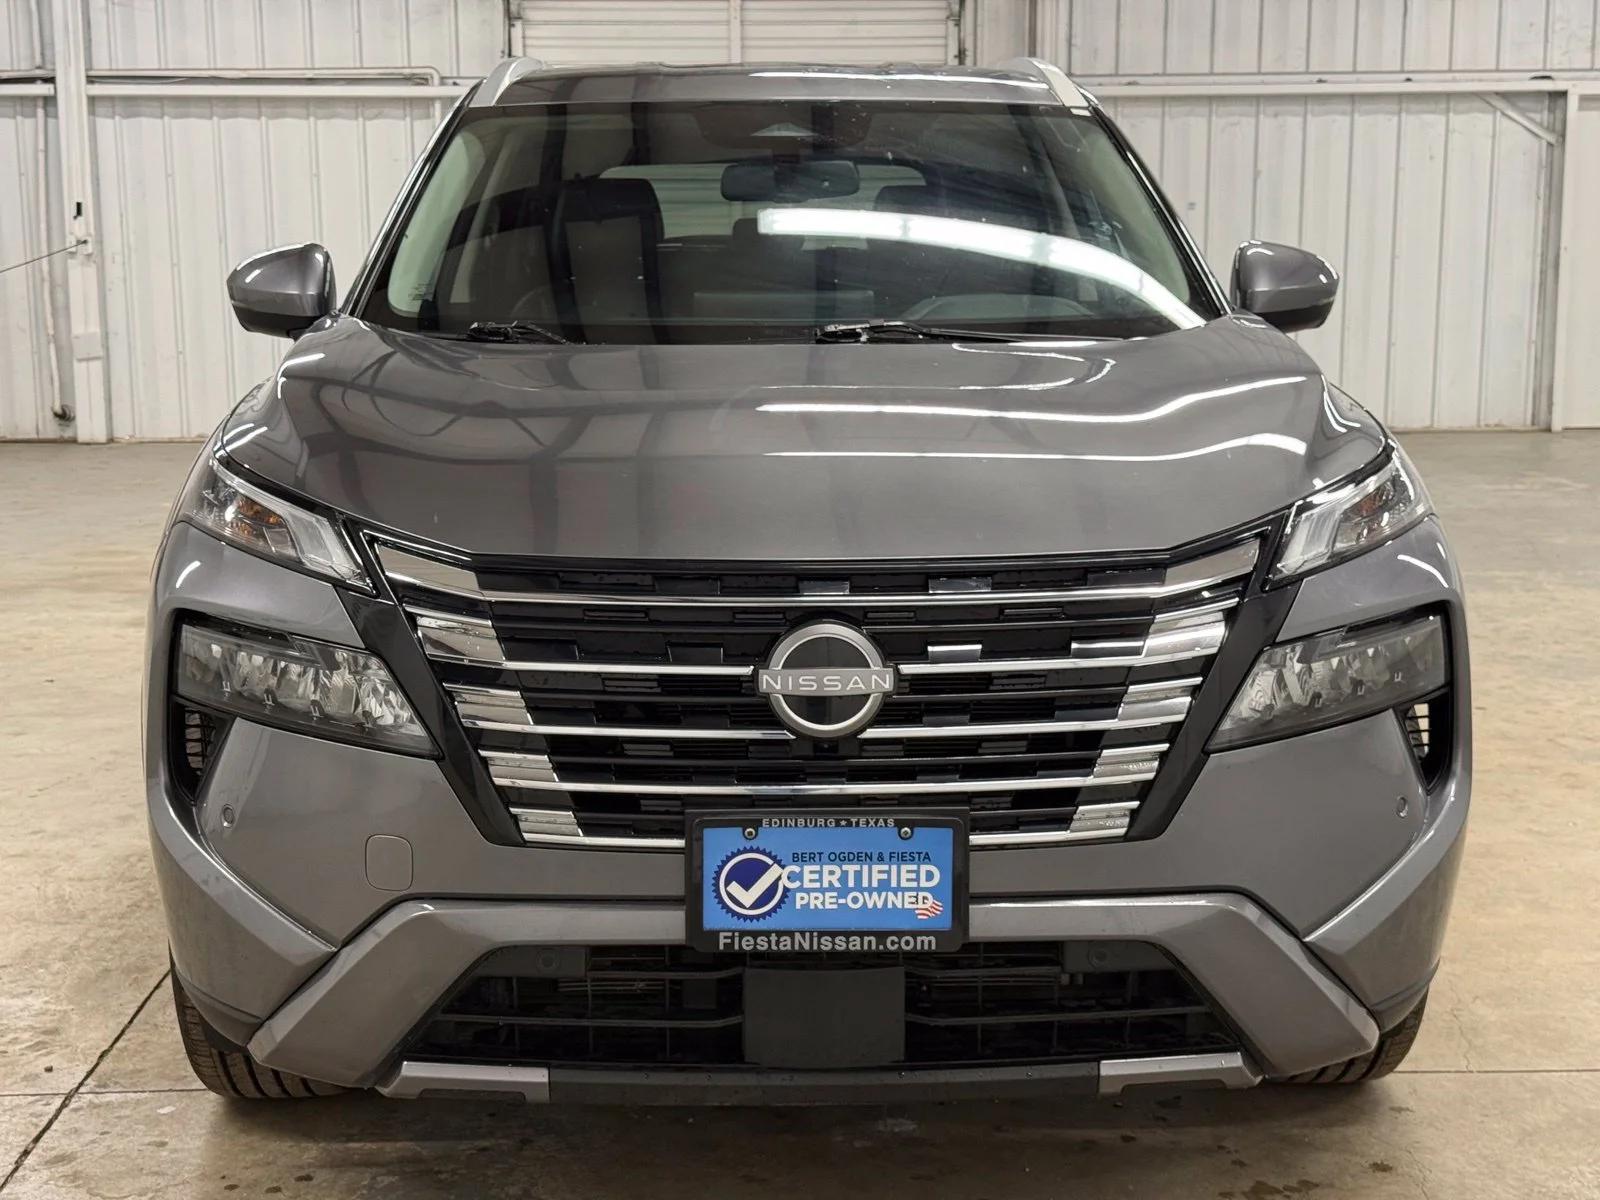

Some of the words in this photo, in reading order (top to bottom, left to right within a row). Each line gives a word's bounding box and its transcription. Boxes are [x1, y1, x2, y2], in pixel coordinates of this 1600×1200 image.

[762, 673, 890, 691] NISSAN
[762, 818, 836, 828] EDINBURG
[850, 818, 895, 828] TEXAS
[792, 852, 824, 863] BERT
[828, 852, 872, 862] OGDEN
[877, 852, 885, 862] &
[889, 851, 931, 862] FIESTA
[781, 864, 941, 889] CERTIFIED
[795, 891, 934, 910] PRE-OWNED
[718, 931, 937, 951] FiestaNissan.com
